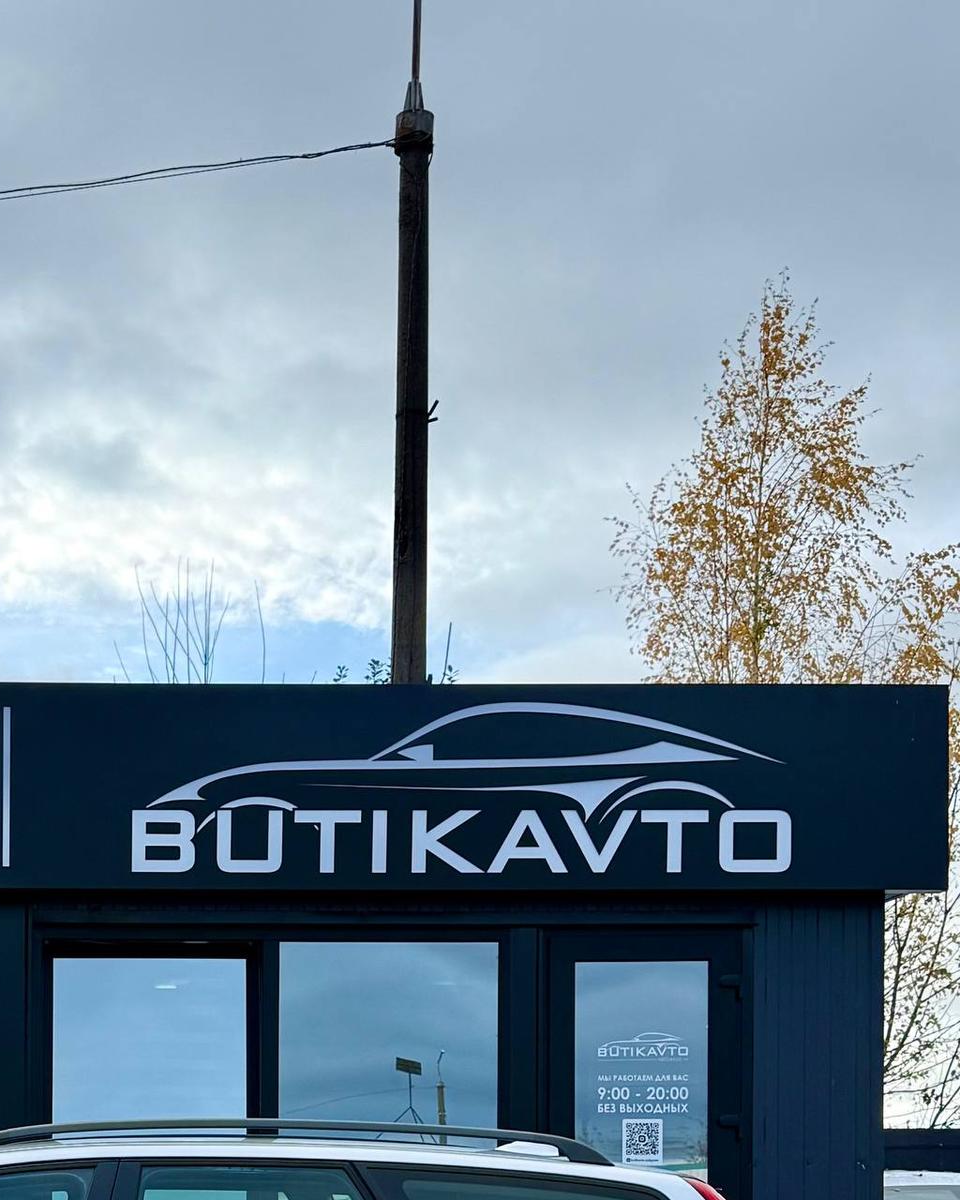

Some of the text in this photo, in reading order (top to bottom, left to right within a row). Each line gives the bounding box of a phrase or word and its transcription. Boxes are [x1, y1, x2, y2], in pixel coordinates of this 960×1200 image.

[131, 808, 792, 874] BUTIKAVTO
[597, 1046, 688, 1057] BUTIKAVTO
[613, 1074, 653, 1082] РАБОТАЕМ
[655, 1074, 671, 1082] ДЛЯ
[672, 1074, 688, 1082] ВАС
[597, 1087, 630, 1100] 9:00
[646, 1087, 688, 1100] 20:00
[597, 1103, 688, 1114] БЕЗ ВЫХОДНЫХ
